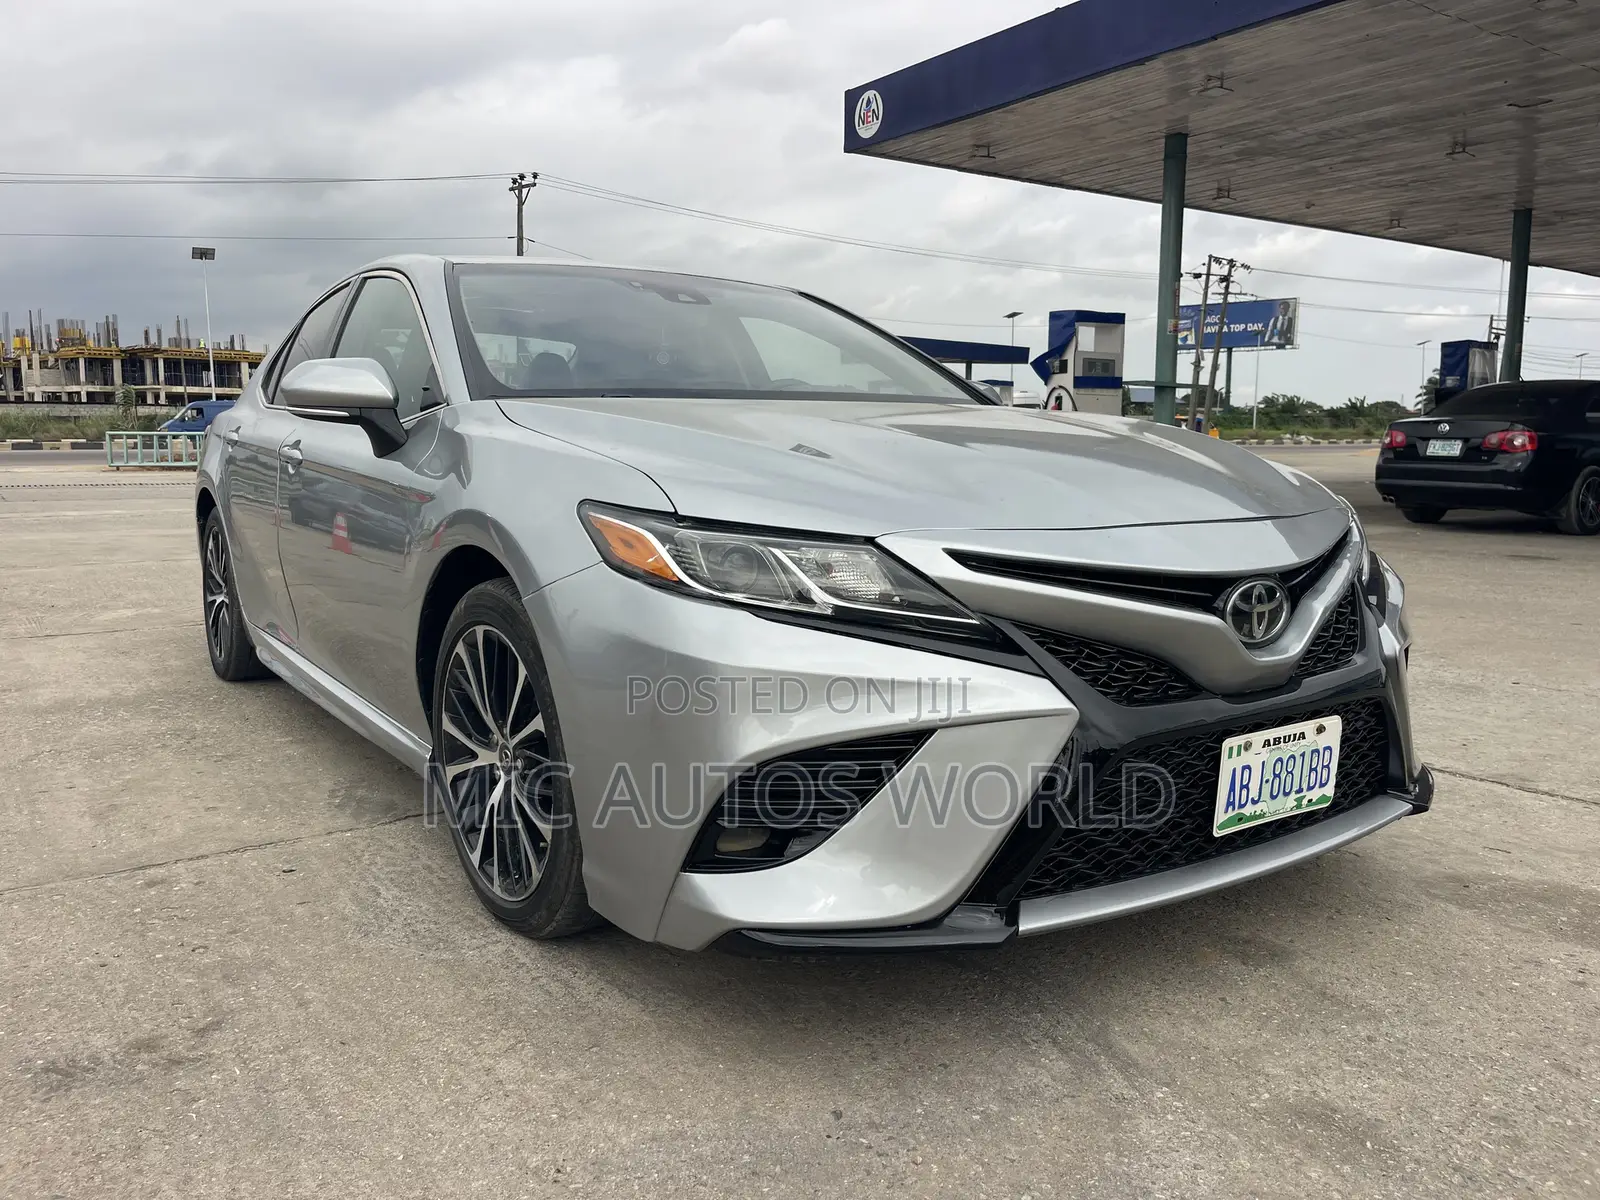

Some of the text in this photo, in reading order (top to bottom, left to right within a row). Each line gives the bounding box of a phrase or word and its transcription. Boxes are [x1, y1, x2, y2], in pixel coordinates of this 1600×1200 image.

[1230, 323, 1245, 332] TOP
[1247, 322, 1265, 330] DAY.
[1261, 731, 1306, 748] ABUJA
[1224, 745, 1333, 813] ABJ-881BB
